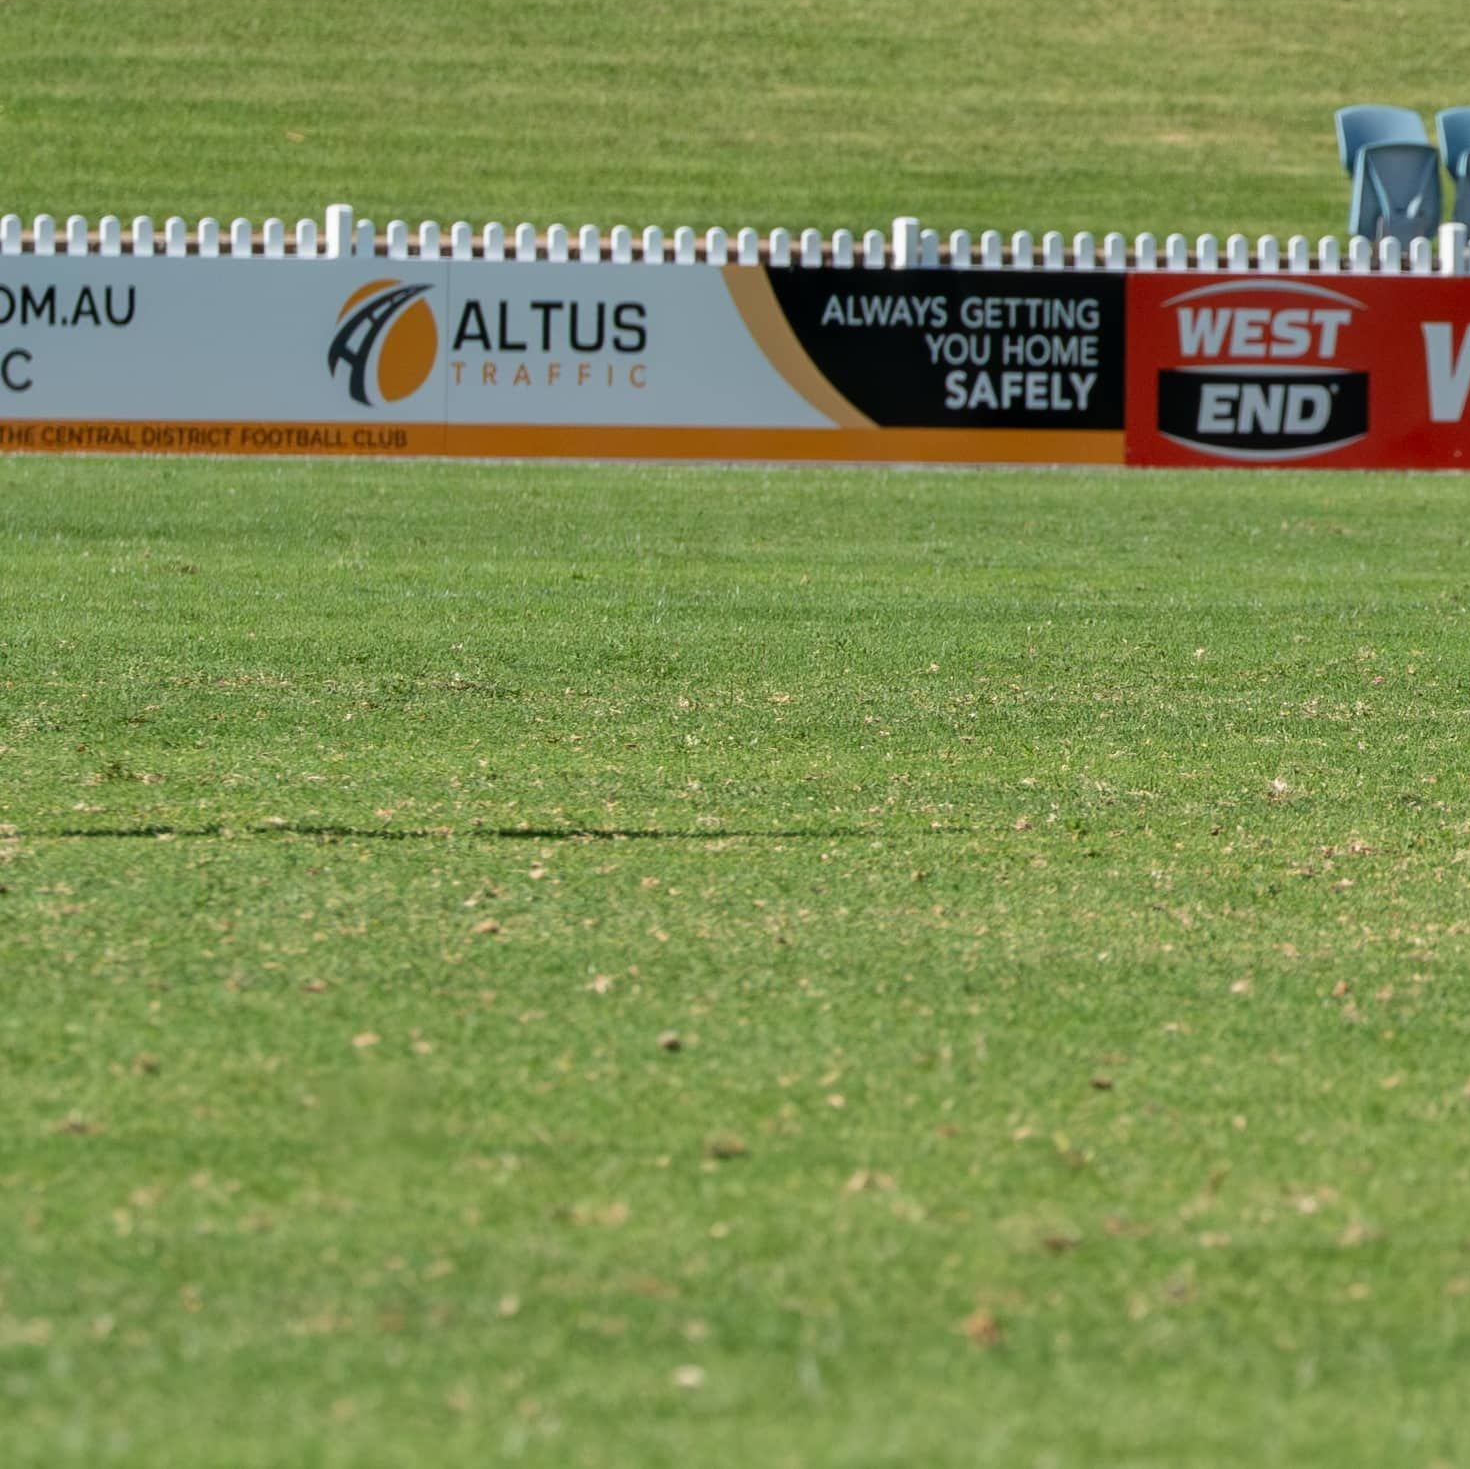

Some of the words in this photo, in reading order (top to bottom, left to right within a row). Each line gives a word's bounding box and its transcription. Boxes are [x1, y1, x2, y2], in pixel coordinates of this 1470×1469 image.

[452, 300, 648, 353] ALTUS
[821, 294, 948, 328] ALWAYS
[960, 296, 1099, 330] GETTING
[925, 333, 991, 365] YOU
[1002, 334, 1098, 367] HOME
[1177, 307, 1352, 358] WEST
[451, 362, 647, 388] TRAFFIC
[945, 370, 1097, 410] SAFELY
[1196, 383, 1332, 435] END
[42, 425, 135, 447] CENTRAL
[141, 426, 232, 447] DISTRICT
[240, 427, 345, 449] FOOTBALL
[352, 428, 408, 450] CLUB
